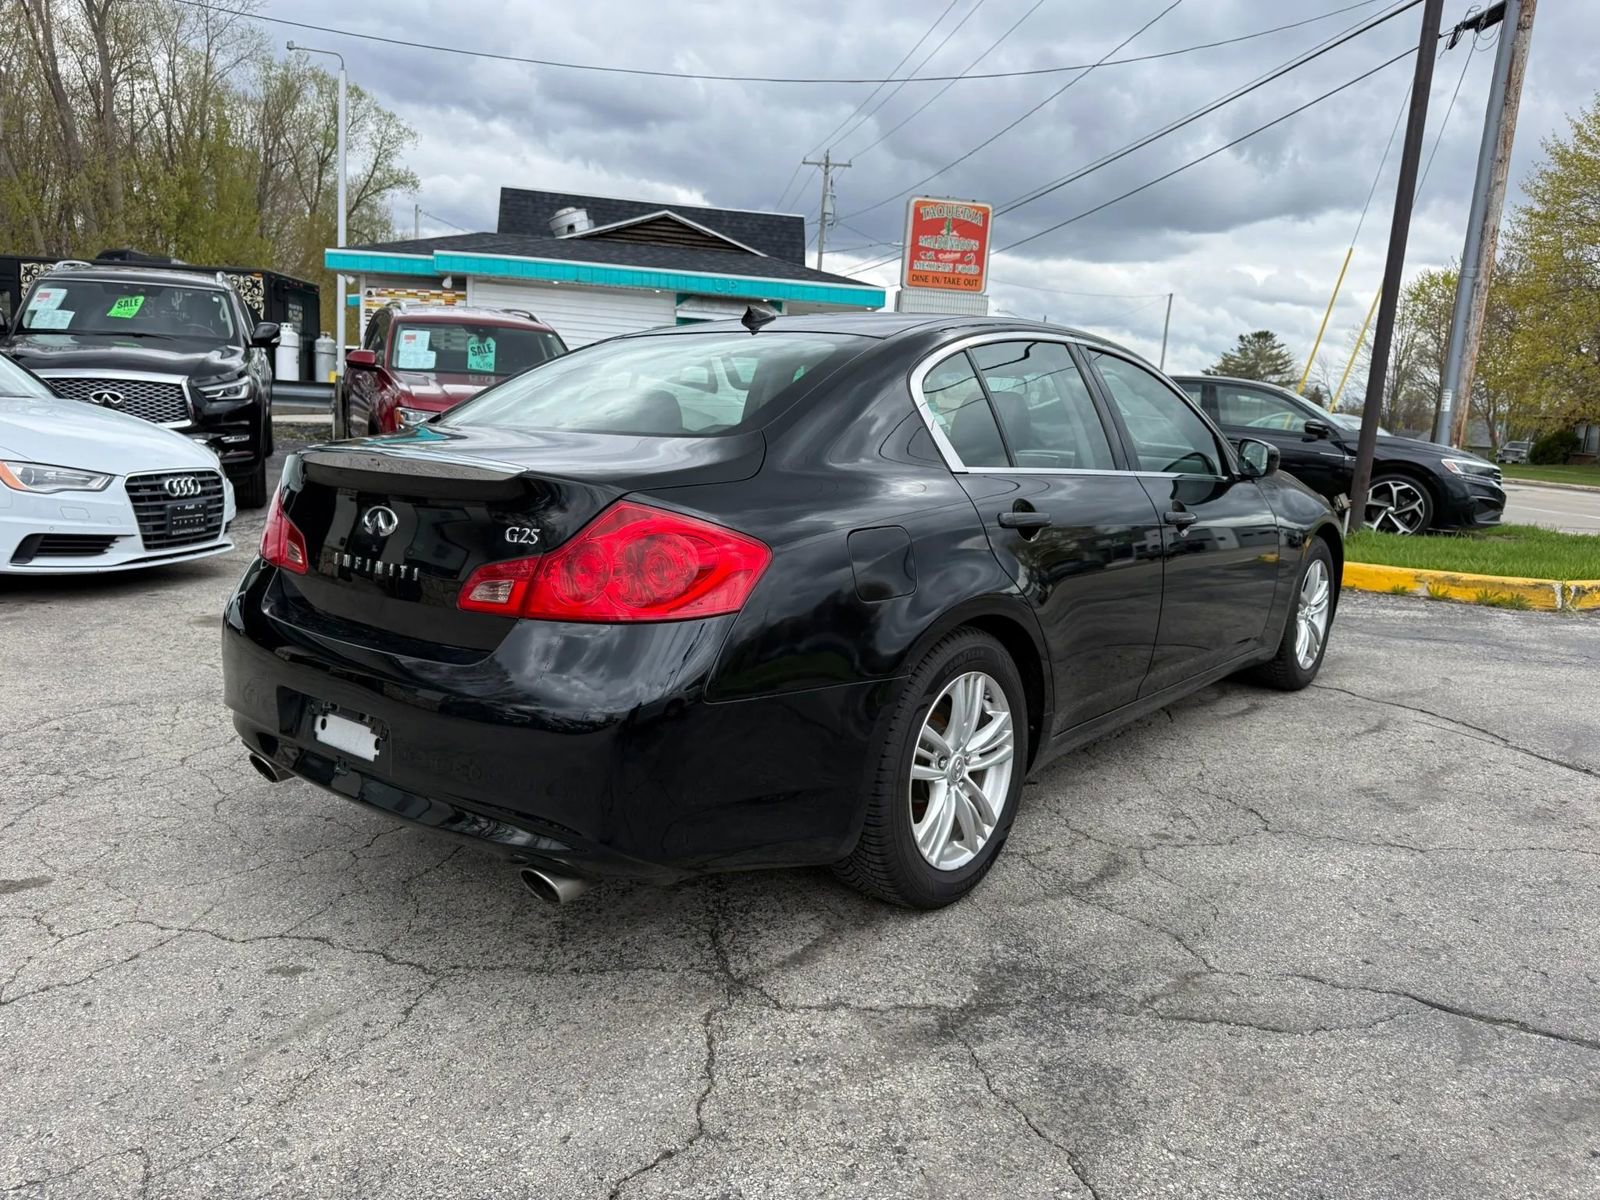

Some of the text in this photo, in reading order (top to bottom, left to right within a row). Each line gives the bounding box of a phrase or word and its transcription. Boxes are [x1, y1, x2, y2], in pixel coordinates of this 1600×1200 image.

[920, 203, 983, 227] TAQUERIA
[913, 260, 980, 275] MEXICAN FOOD
[911, 274, 929, 283] DINE
[963, 278, 979, 287] OUT
[116, 298, 140, 310] SALE
[470, 343, 494, 357] SALE
[505, 526, 541, 545] G25
[333, 551, 419, 581] INFINITI
